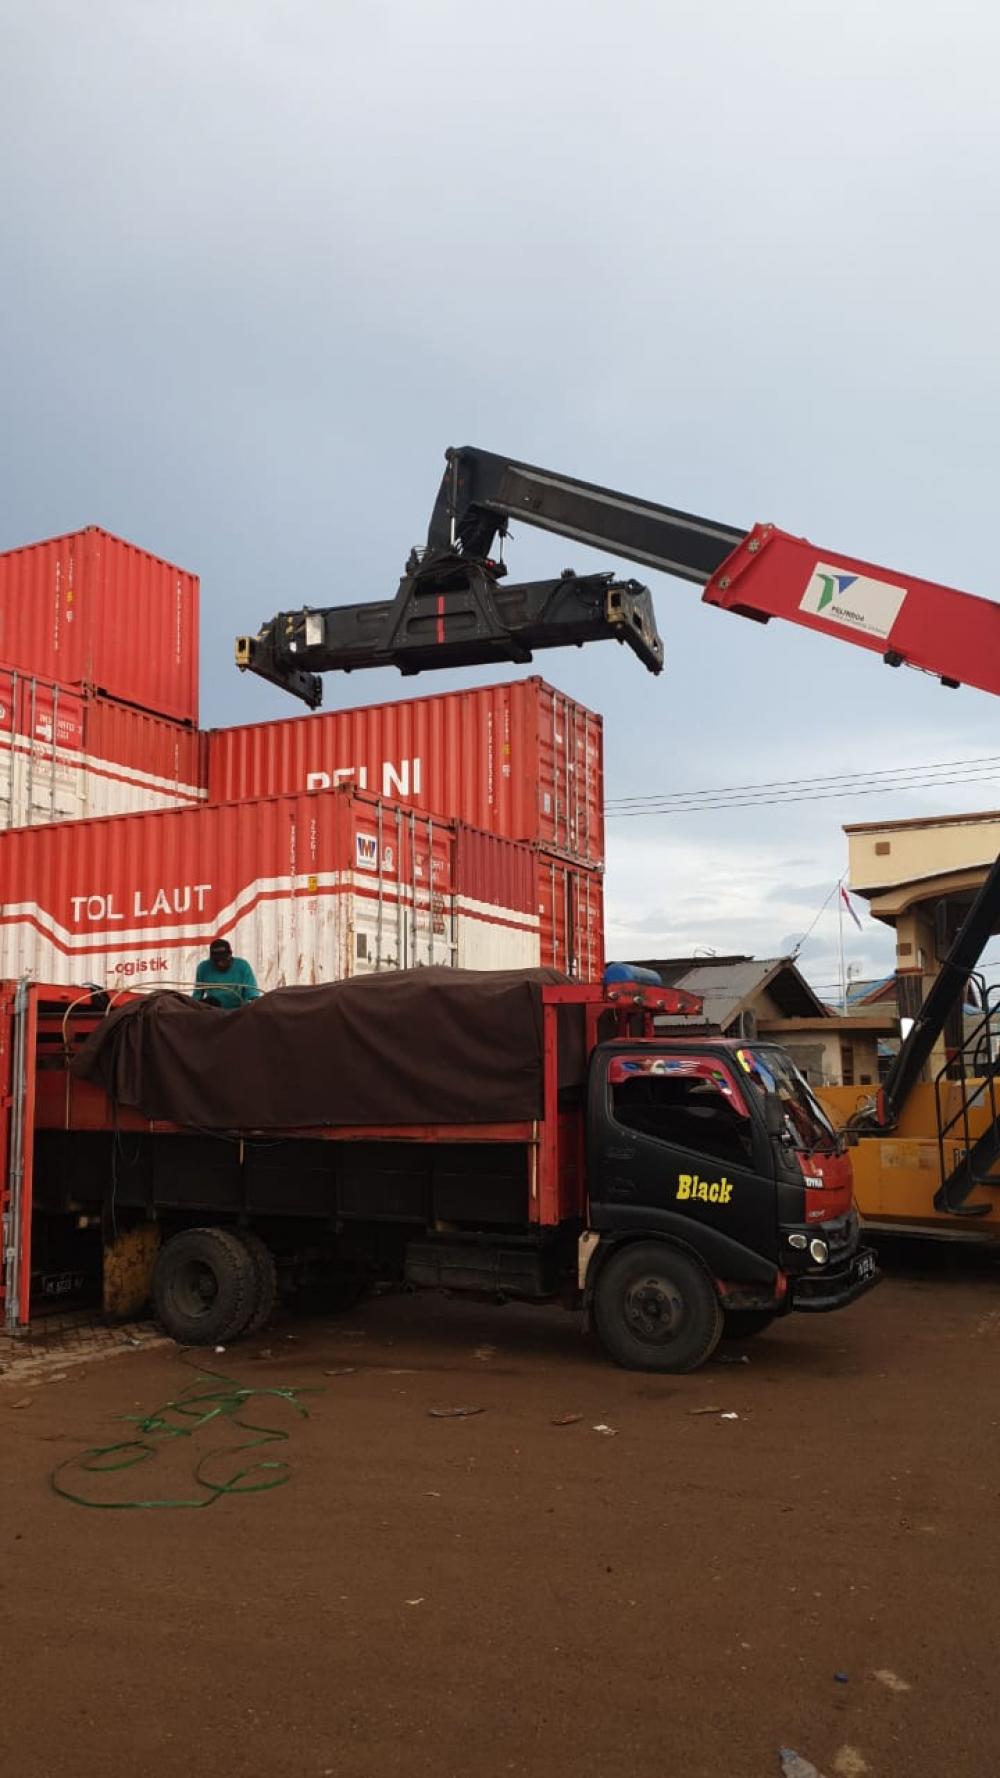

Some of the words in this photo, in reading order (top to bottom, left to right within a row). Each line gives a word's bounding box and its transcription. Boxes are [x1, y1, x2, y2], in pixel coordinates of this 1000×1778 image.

[71, 894, 123, 922] TOL
[134, 884, 212, 918] LAUT
[107, 956, 169, 976] ogistik
[676, 1174, 733, 1204] Black
